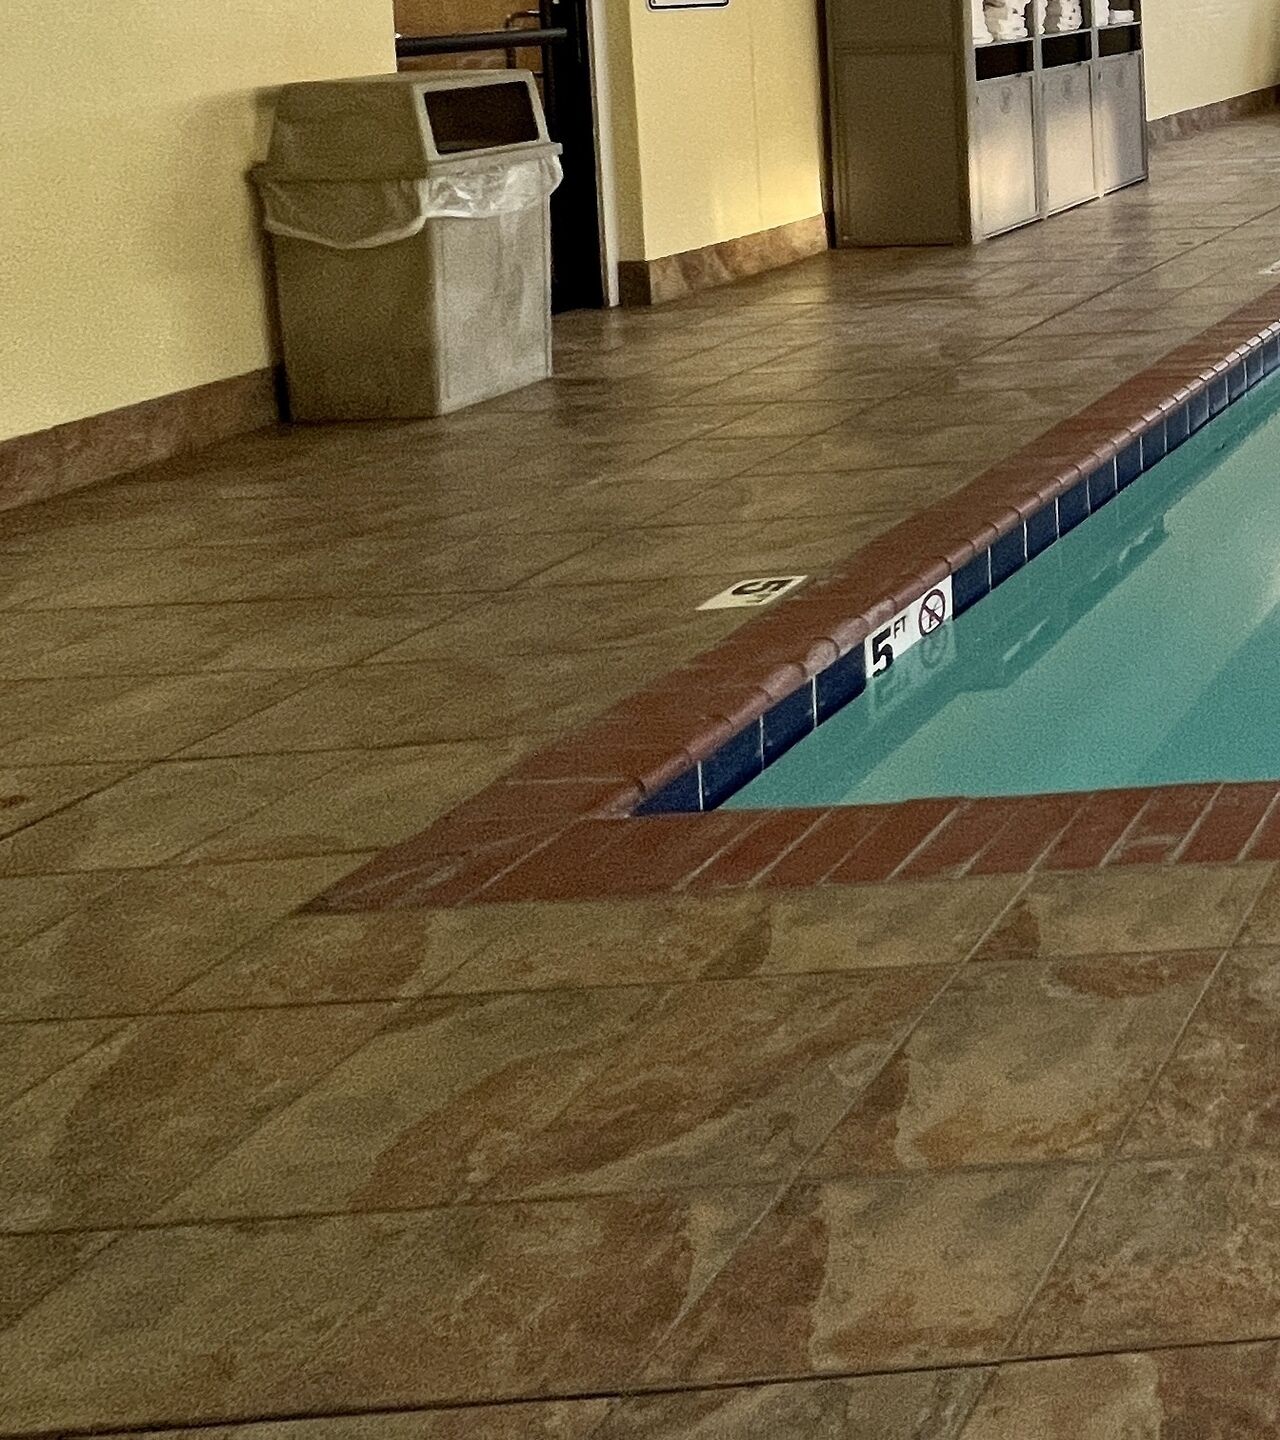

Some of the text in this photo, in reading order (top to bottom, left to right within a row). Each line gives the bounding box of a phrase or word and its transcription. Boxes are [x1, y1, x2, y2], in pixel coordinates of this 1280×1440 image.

[731, 579, 792, 596] 5
[872, 615, 907, 678] 5 FT
